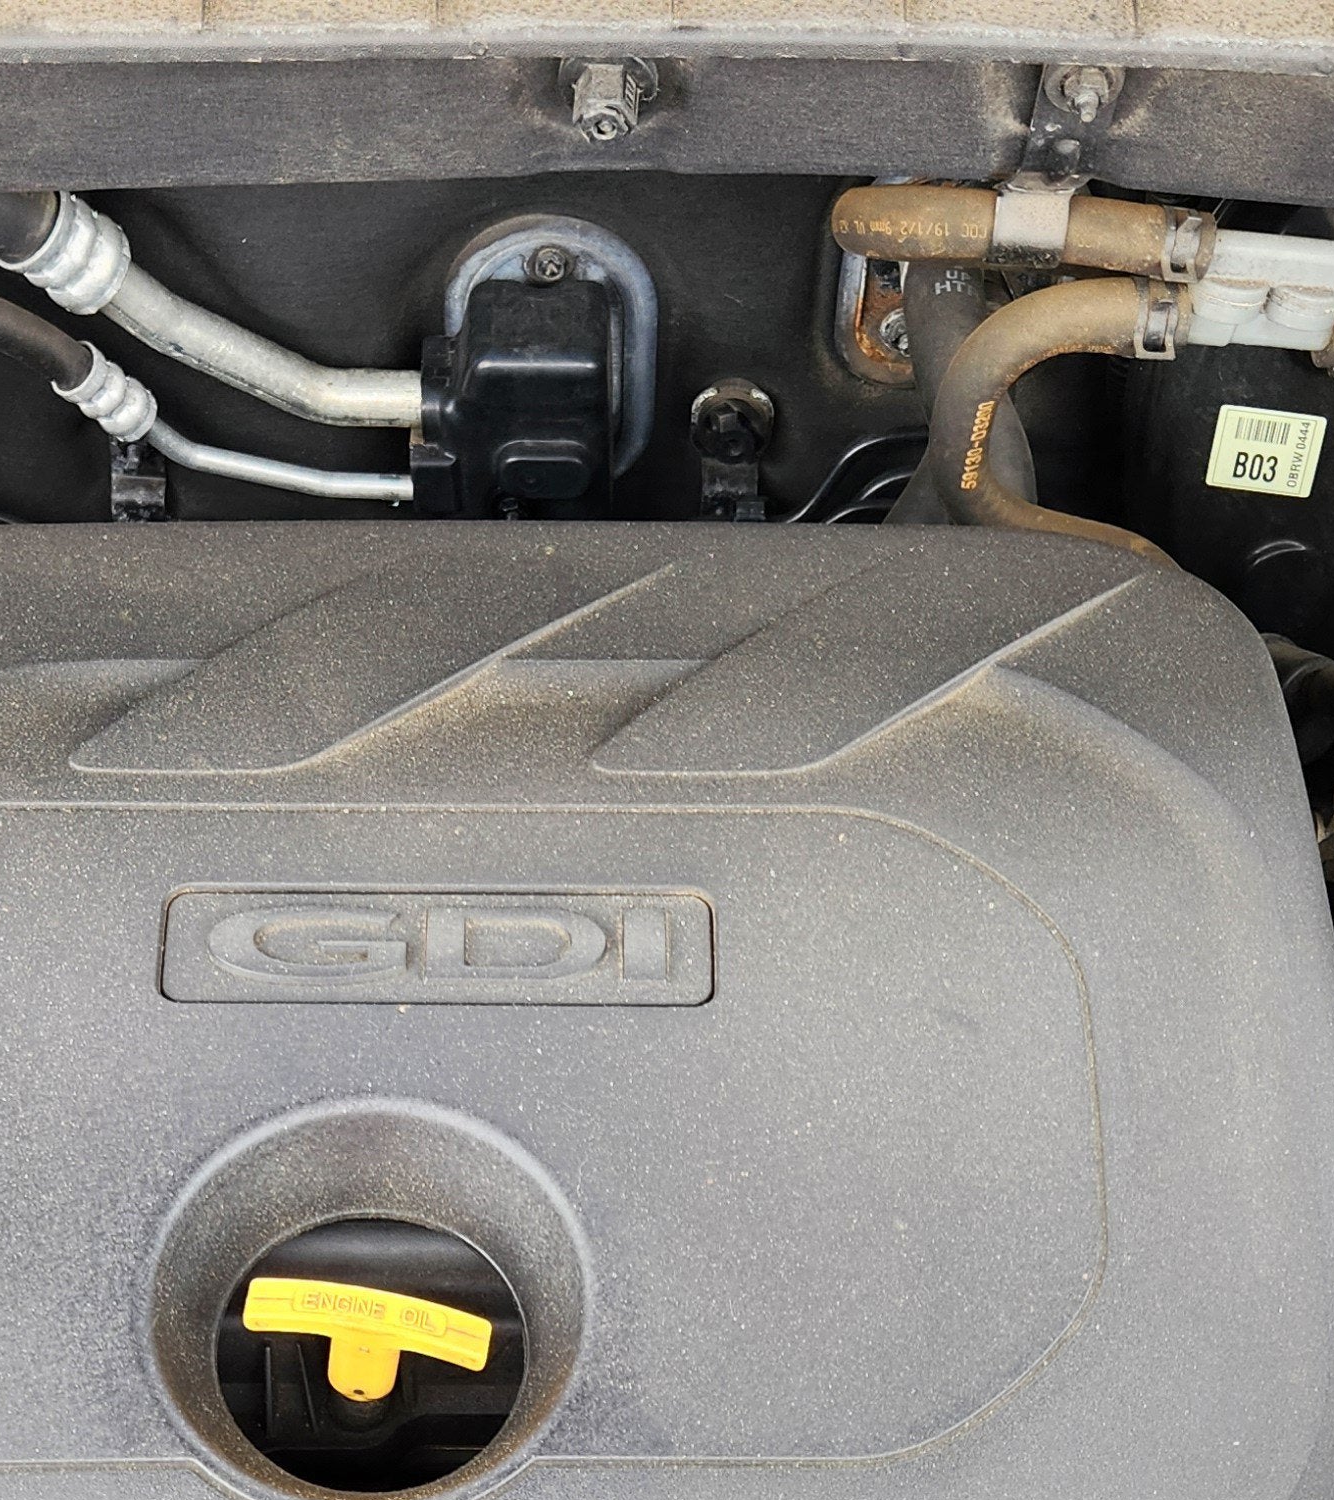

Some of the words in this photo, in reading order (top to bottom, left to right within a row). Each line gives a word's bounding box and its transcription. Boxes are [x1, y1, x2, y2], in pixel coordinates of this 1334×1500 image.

[1233, 451, 1279, 483] B03
[207, 904, 671, 985] GDI
[301, 1290, 386, 1318] ENGINE
[400, 1307, 435, 1331] OIL
